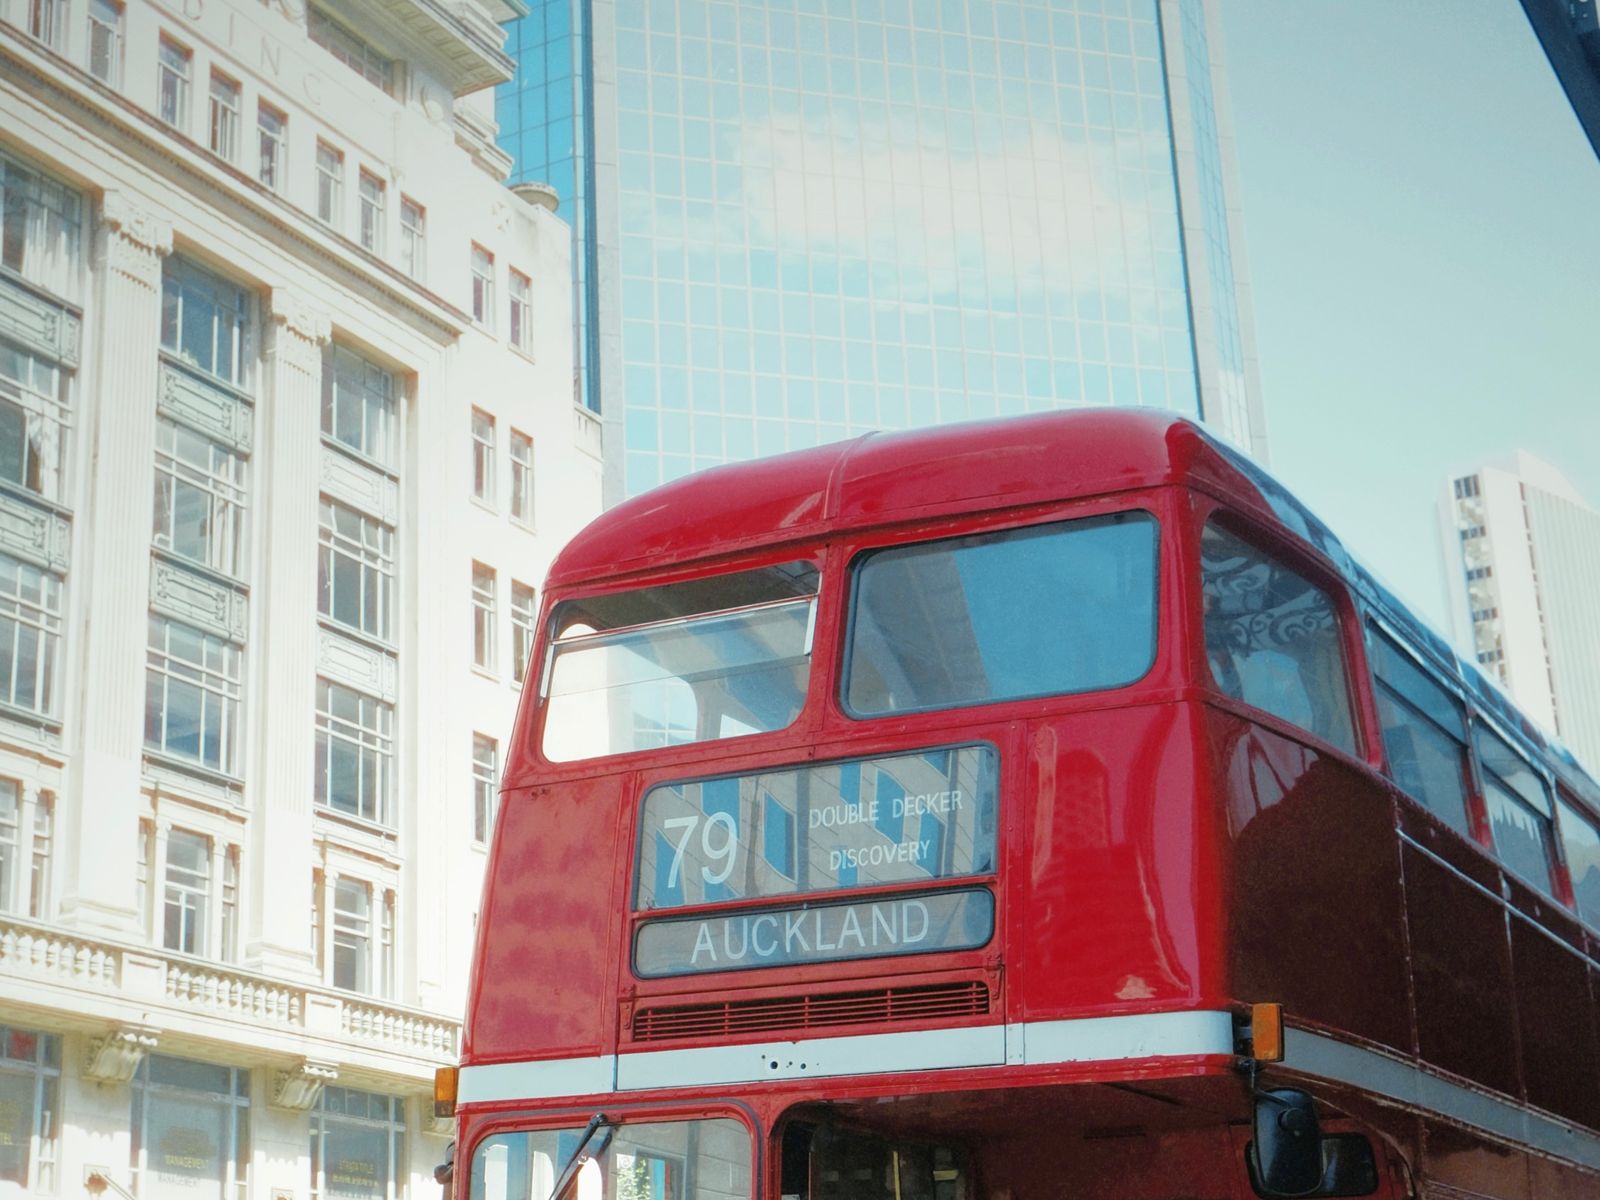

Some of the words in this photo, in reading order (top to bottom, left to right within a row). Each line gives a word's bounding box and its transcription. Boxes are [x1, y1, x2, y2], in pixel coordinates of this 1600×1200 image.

[809, 800, 880, 829] DOUBLE
[892, 789, 964, 819] DECKER
[663, 811, 738, 889] 79
[829, 839, 932, 872] DISCOVERY
[689, 900, 930, 964] AUCKLAND
